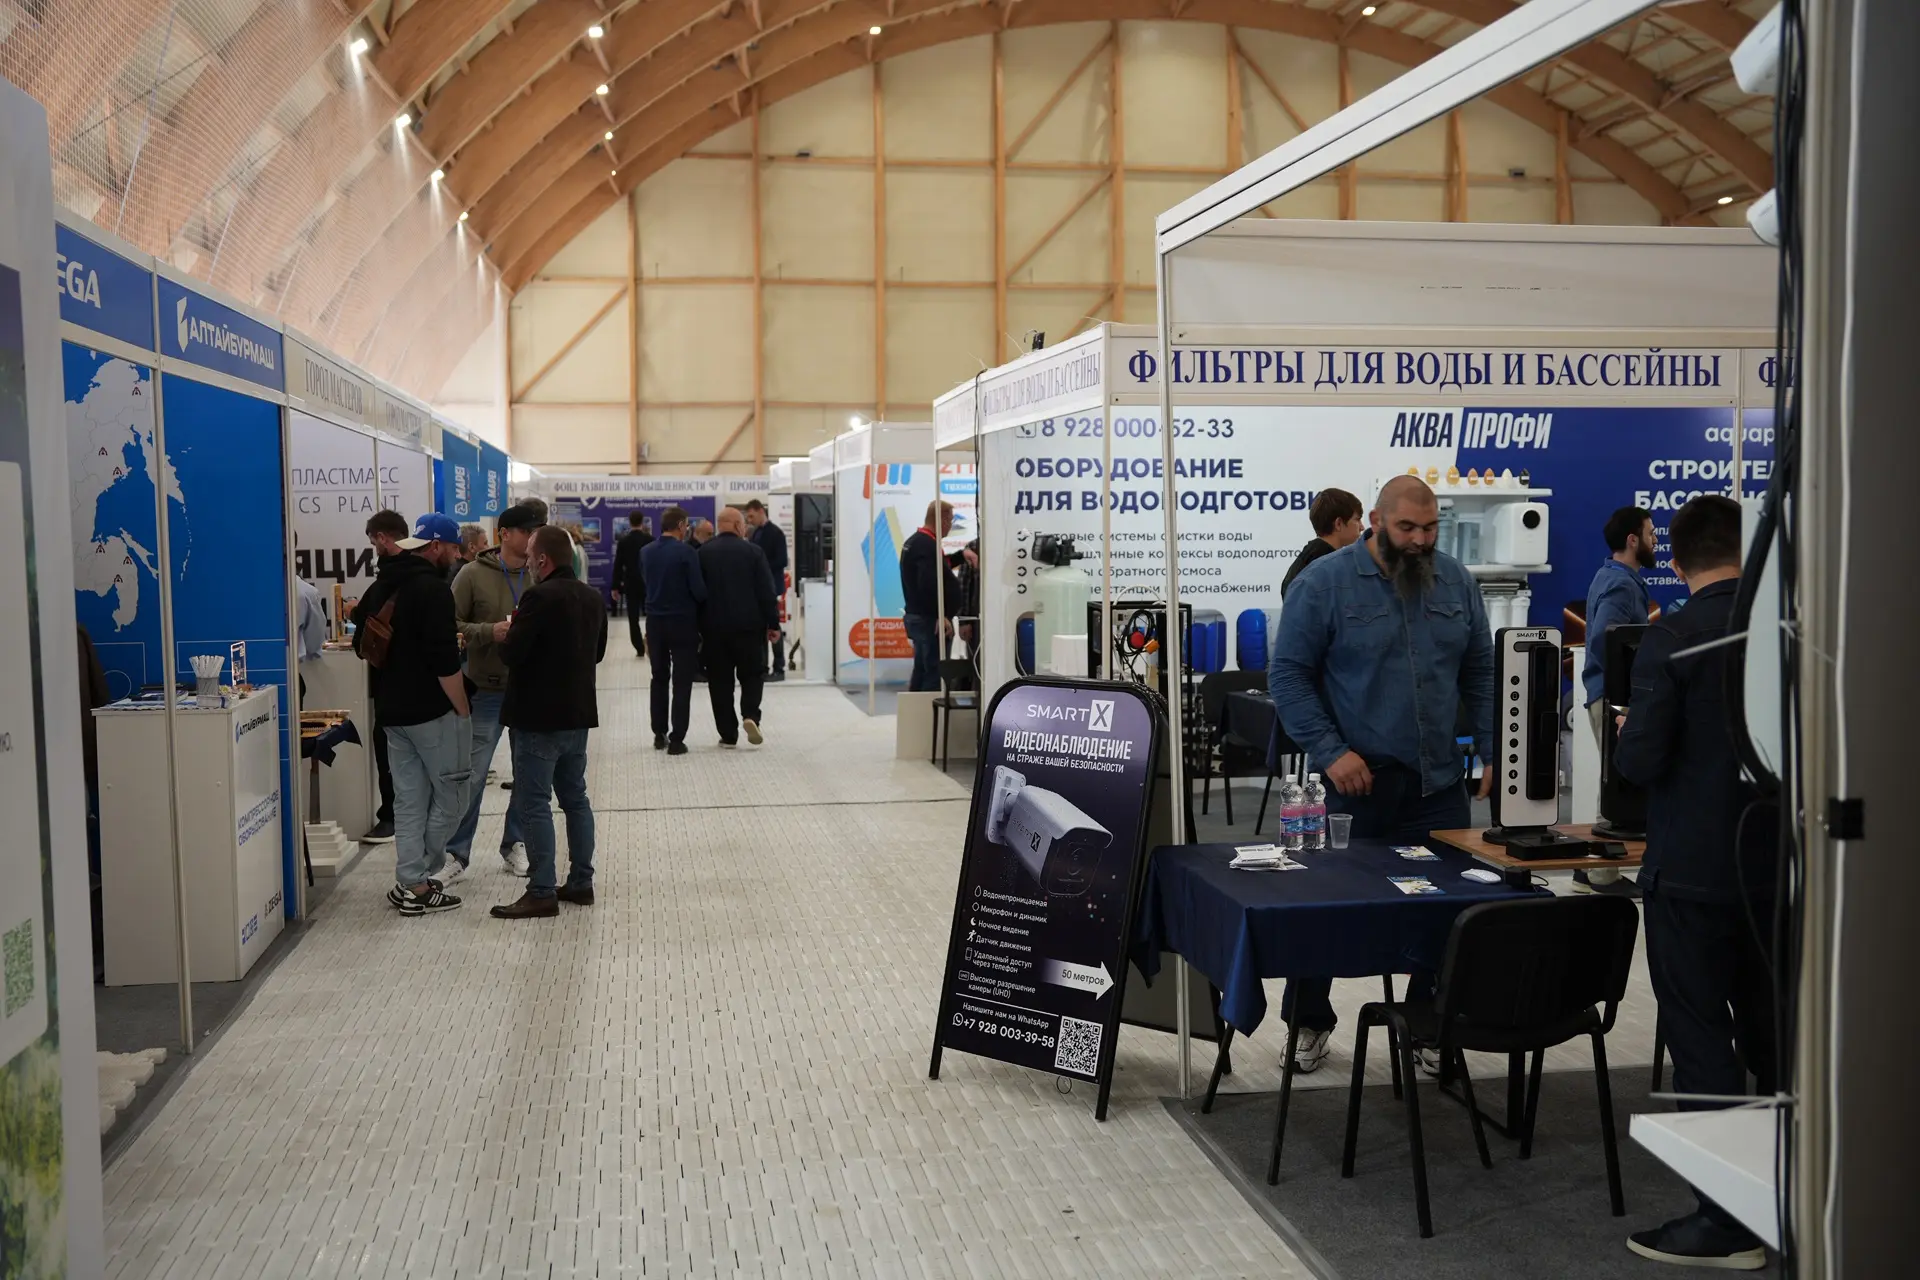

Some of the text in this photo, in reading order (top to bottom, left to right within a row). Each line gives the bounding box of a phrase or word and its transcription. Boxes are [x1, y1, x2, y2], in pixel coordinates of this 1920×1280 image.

[189, 317, 275, 370] АЛТАЙБУРМАШ
[305, 358, 329, 401] ГОРОД
[1054, 349, 1101, 396] БАССЕЙНЫ
[1128, 348, 1722, 394] ФИЛЬТРЫ ДЛЯ ВОДЫ И БАССЕЙНЫ
[1041, 418, 1056, 437] 8
[1064, 417, 1103, 438] 928
[1389, 412, 1553, 449] АКВА ПРОФИ
[292, 466, 400, 486] ПЛАСТМАСС
[1015, 457, 1244, 482] ОБОРУДОВАНИЕ
[580, 481, 620, 492] РАЗВИТИЯ
[338, 495, 400, 513] PLANT
[1015, 490, 1072, 514] ДЛЯ
[1218, 532, 1253, 542] воды
[1003, 729, 1133, 760] ВИДЕОНАБЛЮДЕНИЕ
[1006, 752, 1125, 773] НА СТРАЖЕ ВАШЕЙ БЕЗОПАСНОСТИ
[982, 889, 1048, 907] Водонепроницаемая
[980, 905, 1013, 917] Микрофон
[1018, 913, 1048, 923] динамик
[978, 919, 1030, 936] Ночное видение
[975, 935, 1032, 952] Датчик движения
[972, 959, 1019, 974] через телефон
[974, 949, 1032, 968] Удаленный доступ
[969, 972, 1036, 993] Высокое разрешение
[1061, 969, 1105, 986] 50 метров
[968, 983, 1012, 999] камеры (UHD)
[962, 1002, 994, 1015] Напишите
[994, 1009, 1007, 1018] нам
[1017, 1014, 1049, 1029] WhatsApp
[963, 1018, 1055, 1048] +7 928 003-39-58
